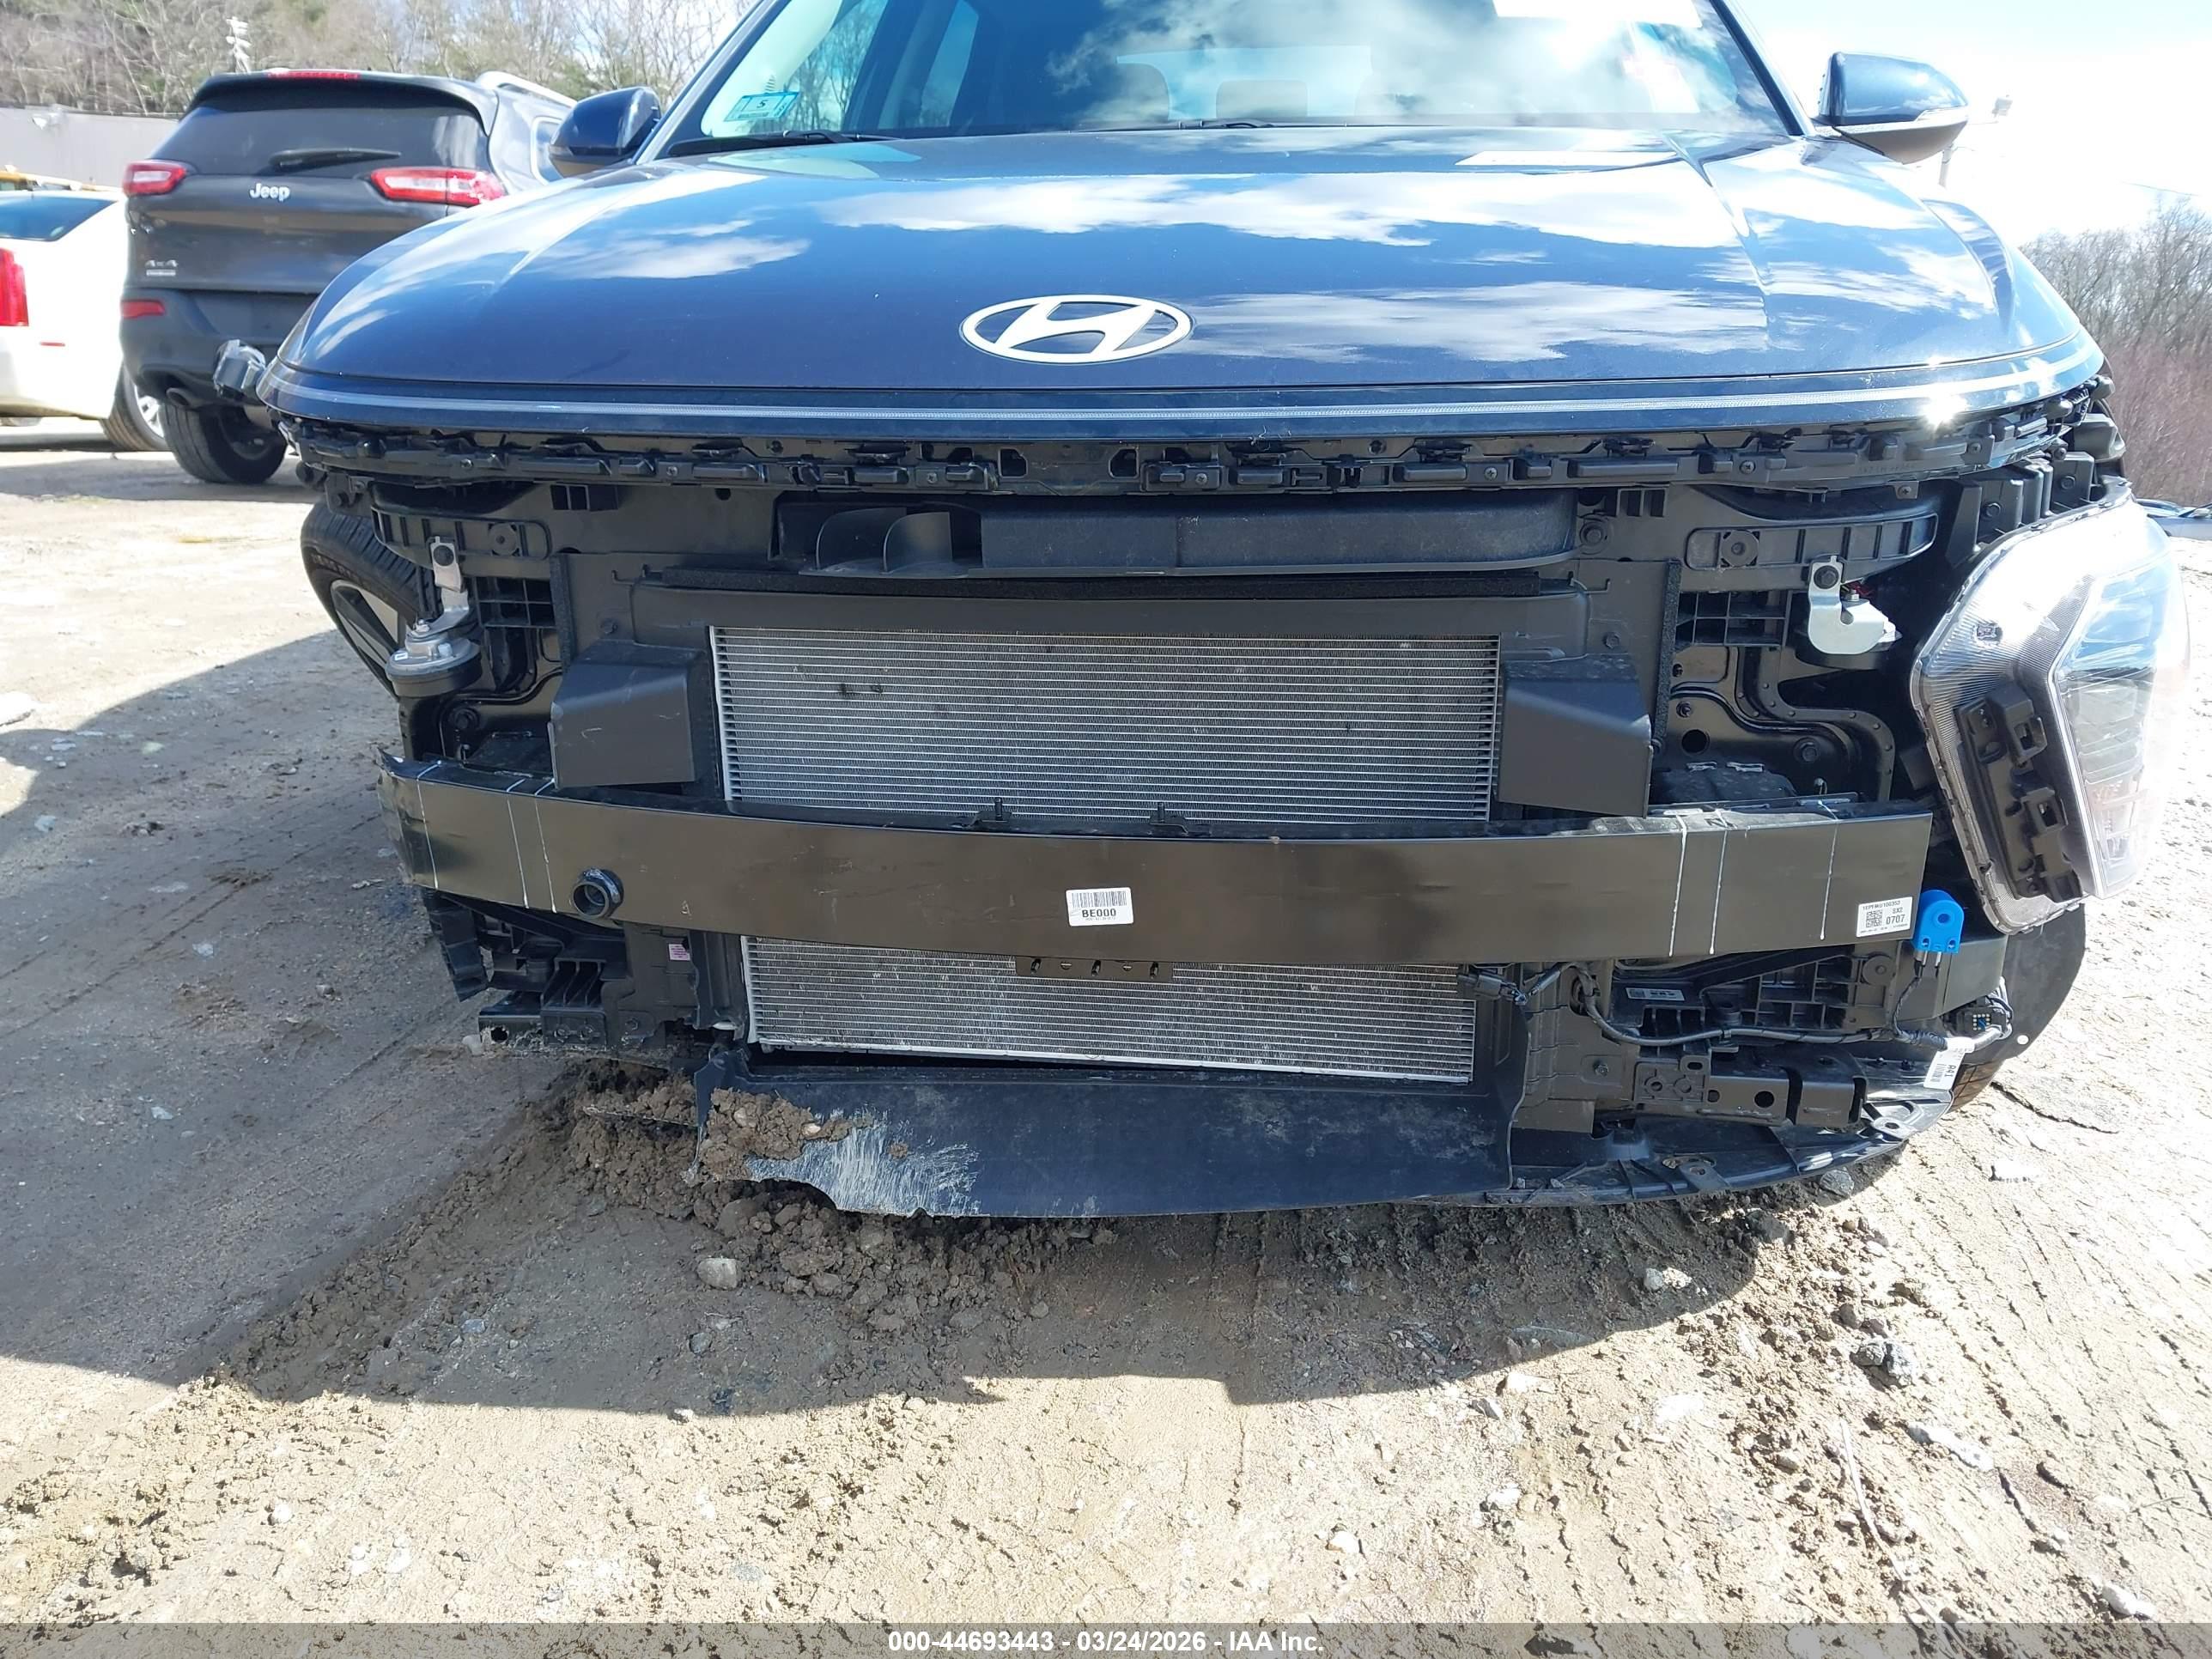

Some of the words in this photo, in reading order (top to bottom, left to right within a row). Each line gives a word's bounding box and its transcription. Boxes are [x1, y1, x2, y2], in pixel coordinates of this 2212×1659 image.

[250, 183, 290, 202] Jeep
[1082, 908, 1116, 918] BE000
[1886, 914, 1906, 925] 0707
